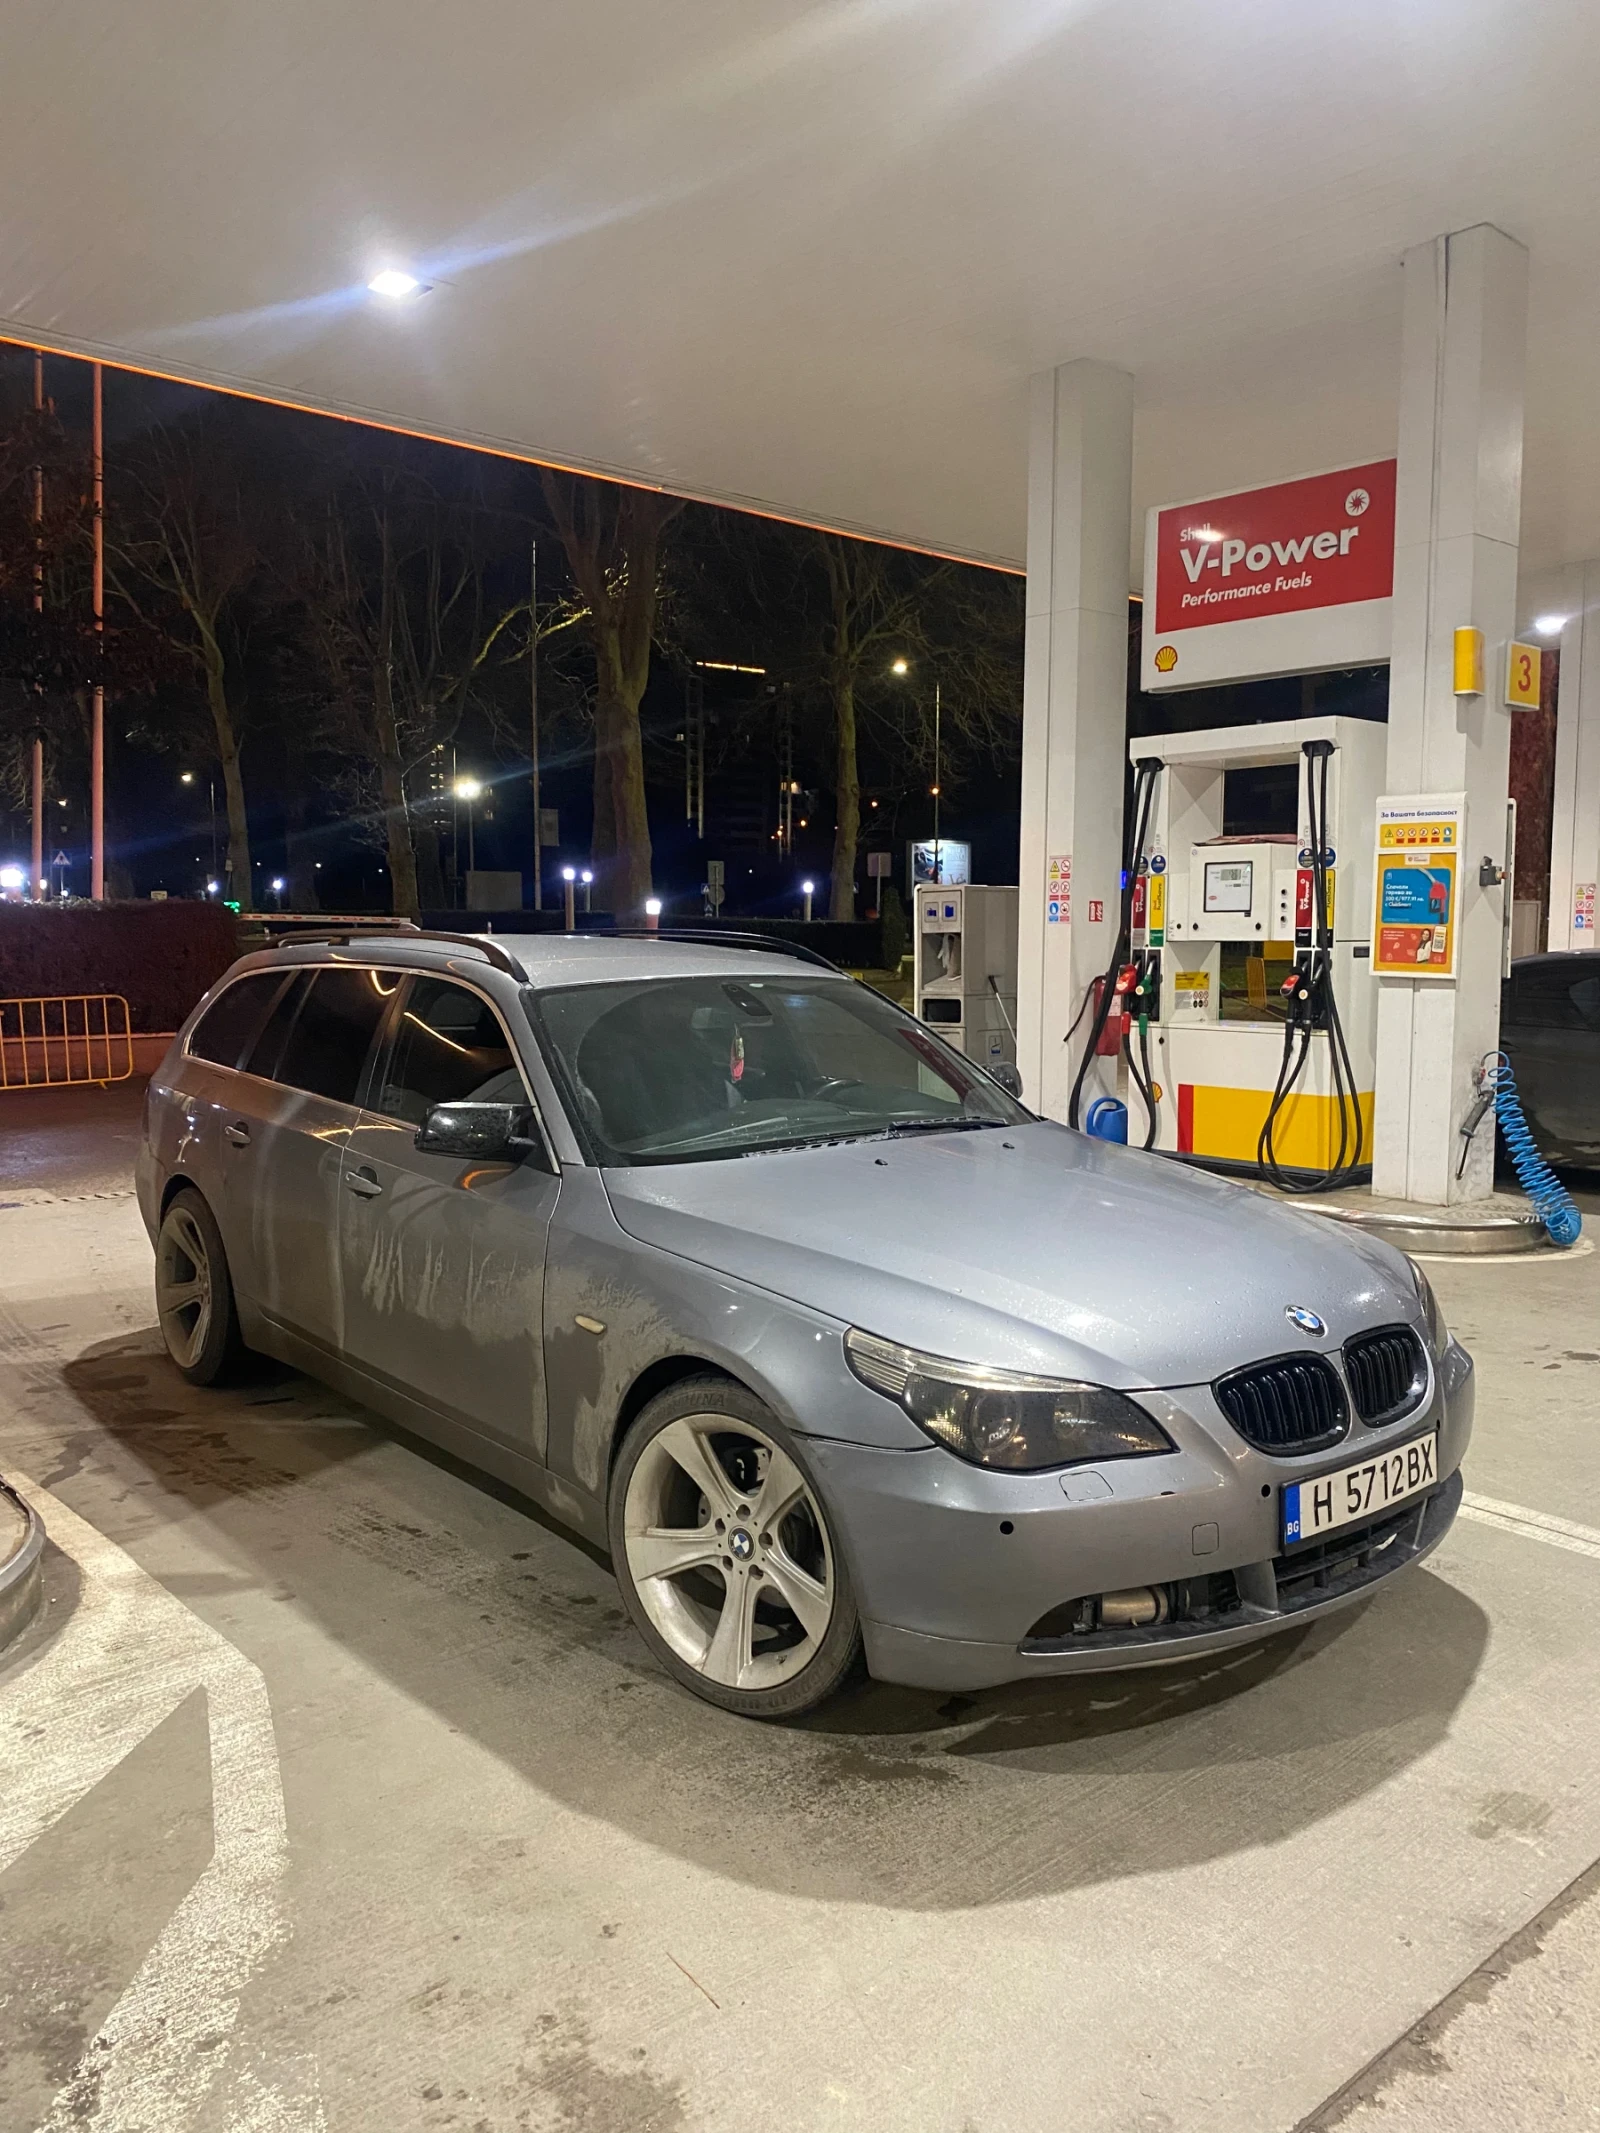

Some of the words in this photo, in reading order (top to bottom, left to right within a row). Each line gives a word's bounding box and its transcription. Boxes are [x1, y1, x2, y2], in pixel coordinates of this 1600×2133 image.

[1180, 526, 1358, 583] V-Power
[1181, 582, 1271, 608] Performance
[1274, 571, 1313, 592] Fuels
[1518, 655, 1531, 692] 3
[1313, 1482, 1333, 1527] H
[1287, 1520, 1300, 1536] BG
